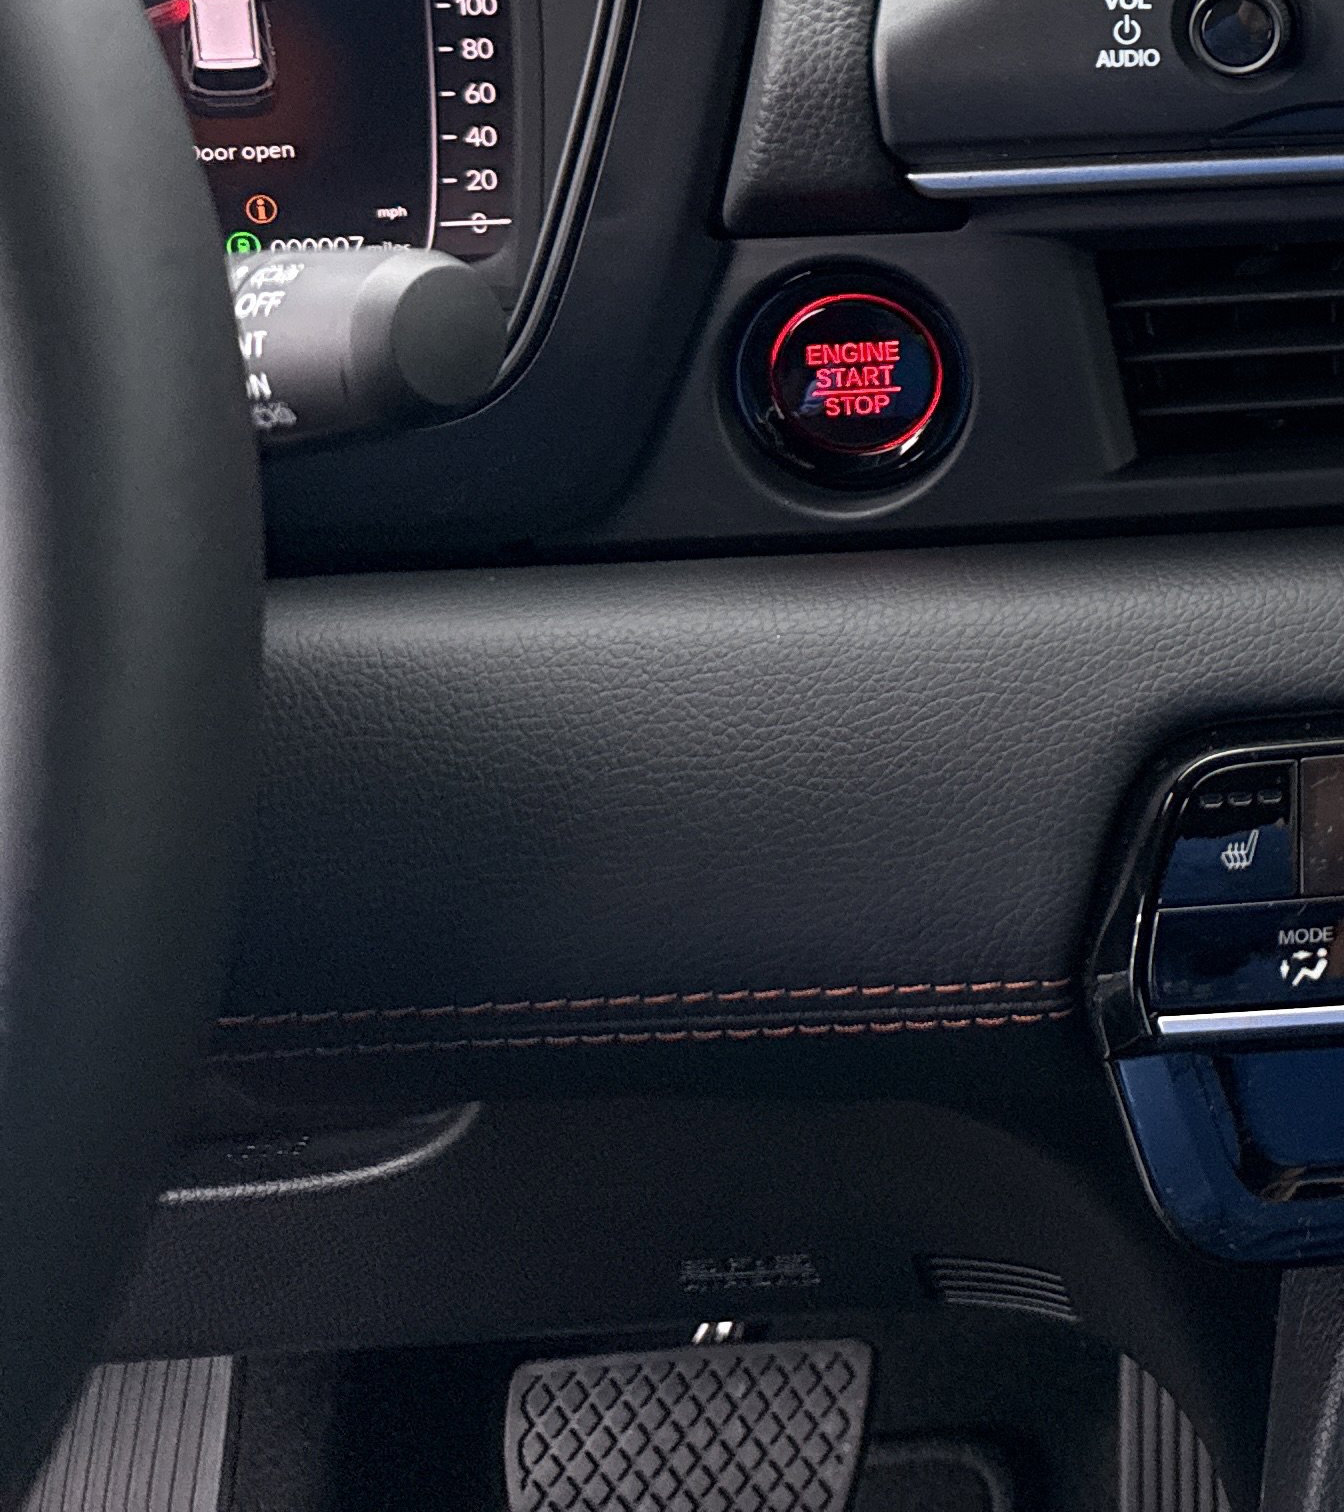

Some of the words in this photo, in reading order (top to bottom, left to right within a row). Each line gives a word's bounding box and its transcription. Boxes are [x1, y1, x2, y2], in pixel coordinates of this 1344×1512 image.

[461, 37, 494, 60] 80
[1095, 48, 1161, 69] AUDIO
[464, 82, 497, 105] 60
[463, 125, 498, 148] 40
[241, 144, 296, 163] open
[465, 169, 498, 191] 20
[376, 205, 408, 221] mph
[235, 291, 286, 319] OFF
[805, 340, 900, 366] ENGINE
[815, 365, 894, 388] START
[824, 394, 891, 416] STOP
[1278, 926, 1334, 945] MODE
